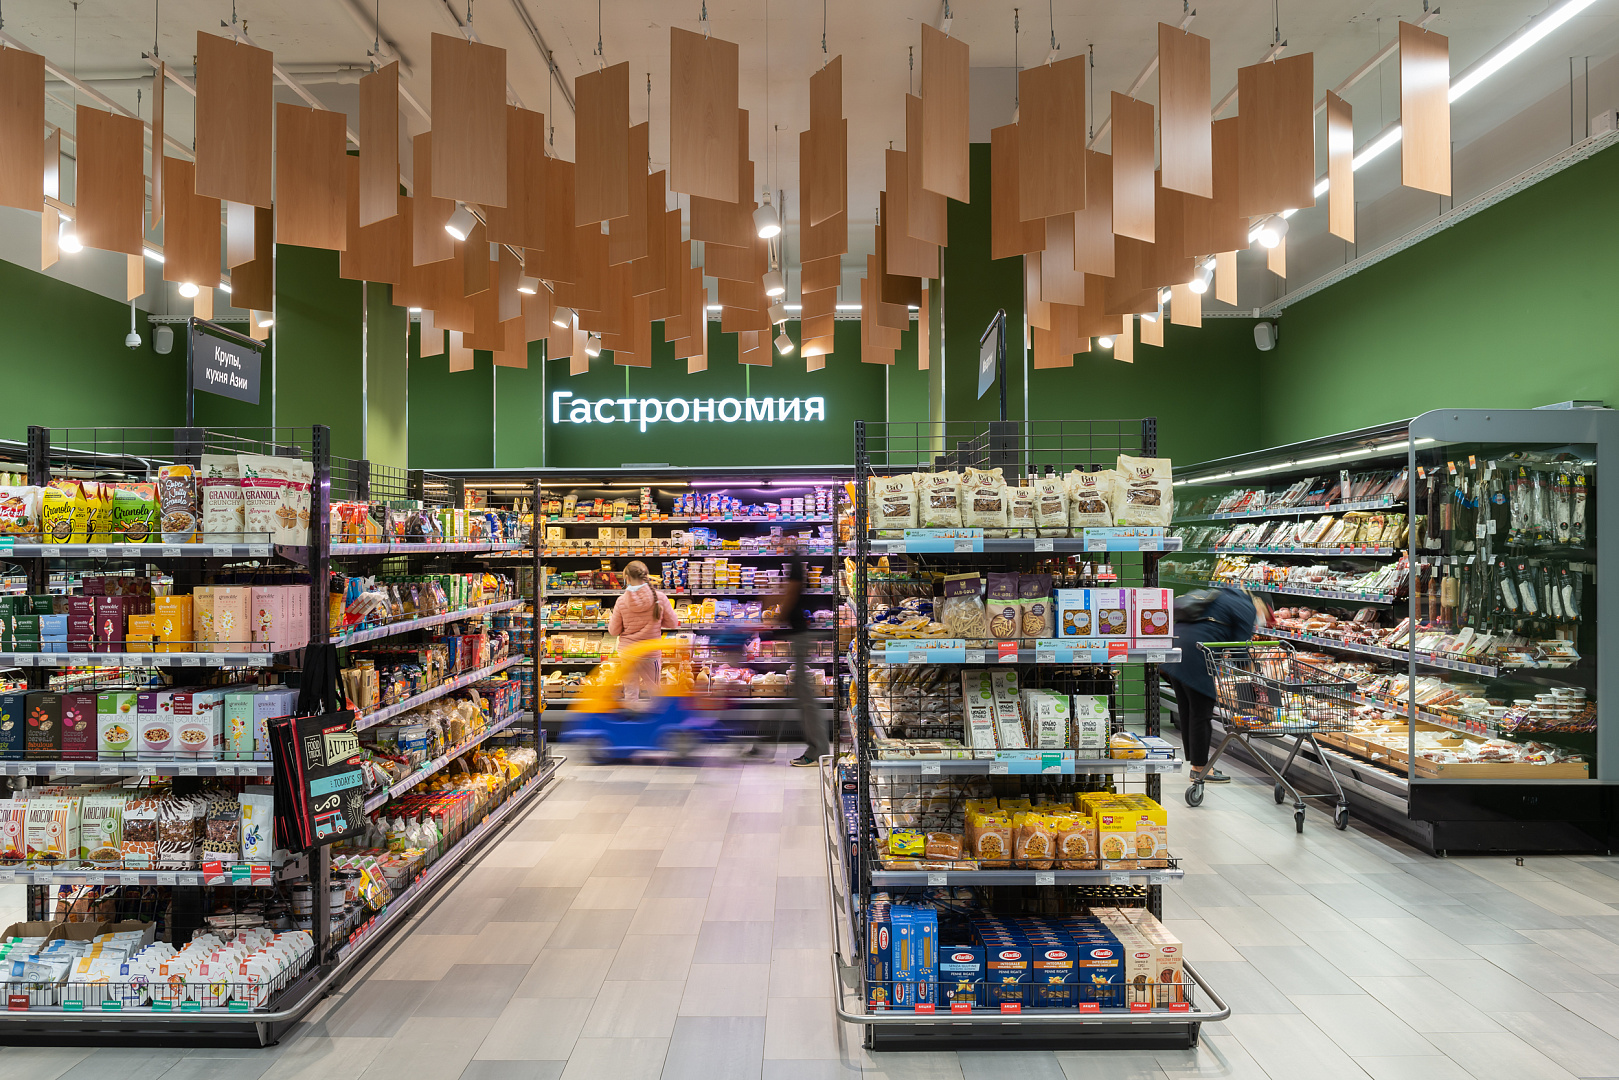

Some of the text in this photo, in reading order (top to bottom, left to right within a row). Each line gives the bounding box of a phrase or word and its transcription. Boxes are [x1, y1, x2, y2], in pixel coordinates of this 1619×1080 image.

[215, 346, 241, 370] Крупы,
[206, 368, 248, 390] кухня Азии
[552, 391, 825, 432] Гастрономия
[166, 480, 184, 490] Super
[168, 488, 186, 500] Nutty
[208, 490, 244, 500] GRANOLA
[246, 490, 280, 500] GRANOLA
[163, 497, 188, 509] Granola
[44, 502, 72, 518] Granola
[114, 504, 150, 520] Granola
[306, 740, 320, 751] FOOD
[308, 750, 321, 759] TRUCK
[334, 774, 355, 788] TODAY'S
